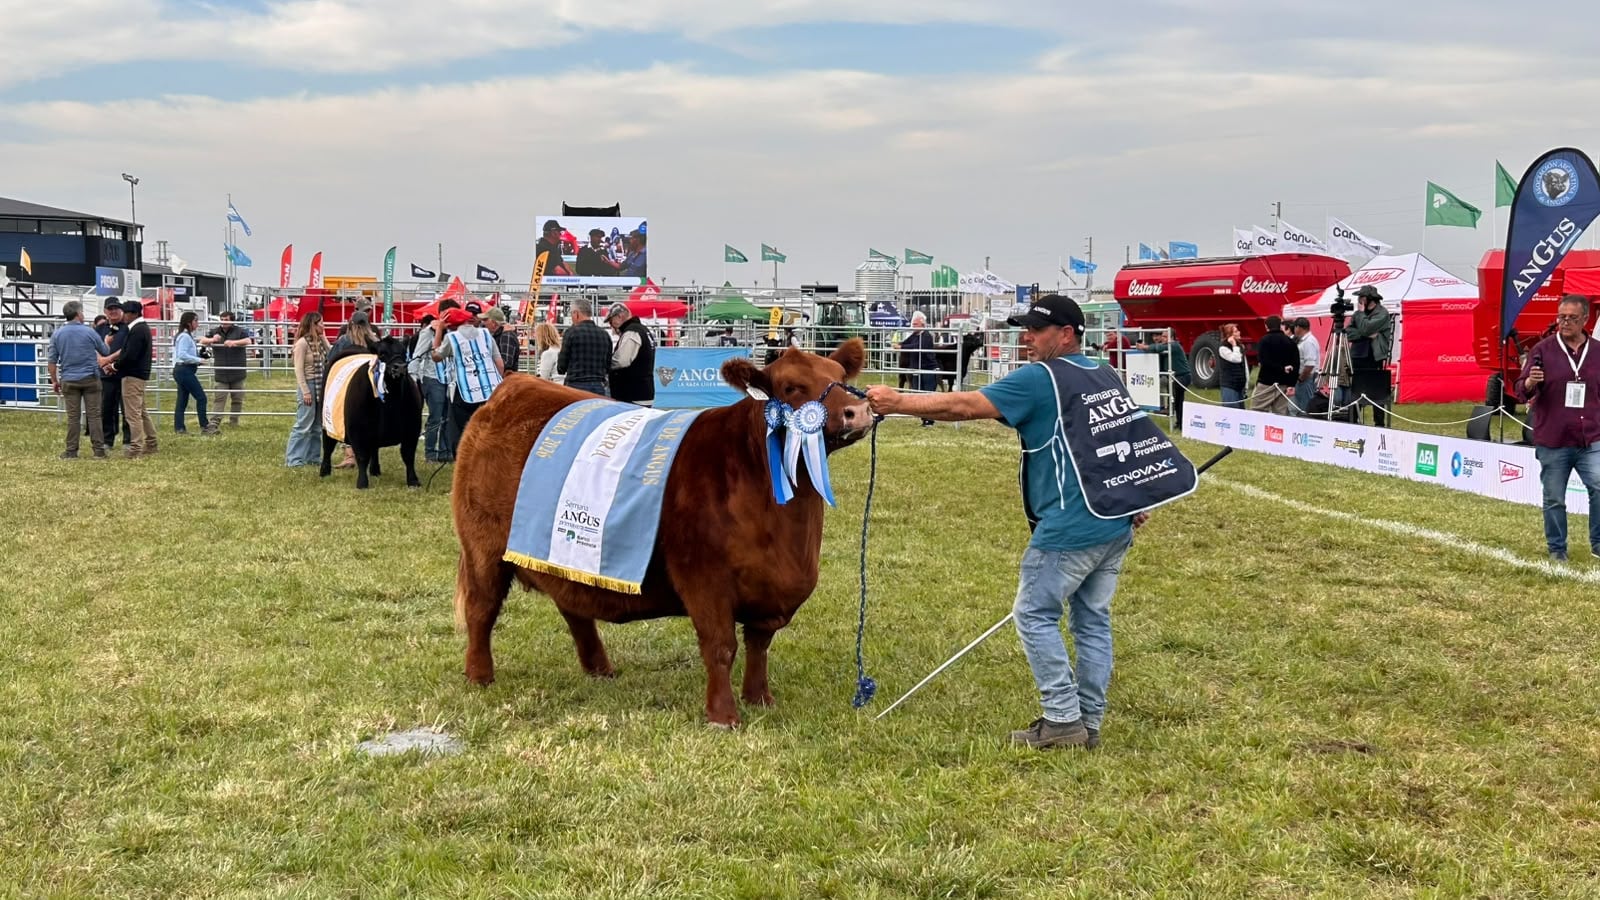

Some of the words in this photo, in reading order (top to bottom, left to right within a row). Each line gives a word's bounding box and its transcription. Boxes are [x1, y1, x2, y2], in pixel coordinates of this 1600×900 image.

[1512, 217, 1575, 298] ANGUS
[100, 274, 119, 289] PRENSA
[1127, 278, 1163, 297] Cestari
[1241, 275, 1289, 294] Cestari
[1081, 388, 1120, 405] Semana
[1090, 414, 1132, 436] primavera
[1132, 436, 1158, 450] Banco
[1134, 441, 1173, 458] Provincia
[642, 443, 671, 486] ANGUS
[1418, 448, 1434, 465] AFA
[1103, 459, 1169, 488] TECNOVAX
[565, 499, 589, 511] Semana
[560, 510, 601, 528] ANGUS
